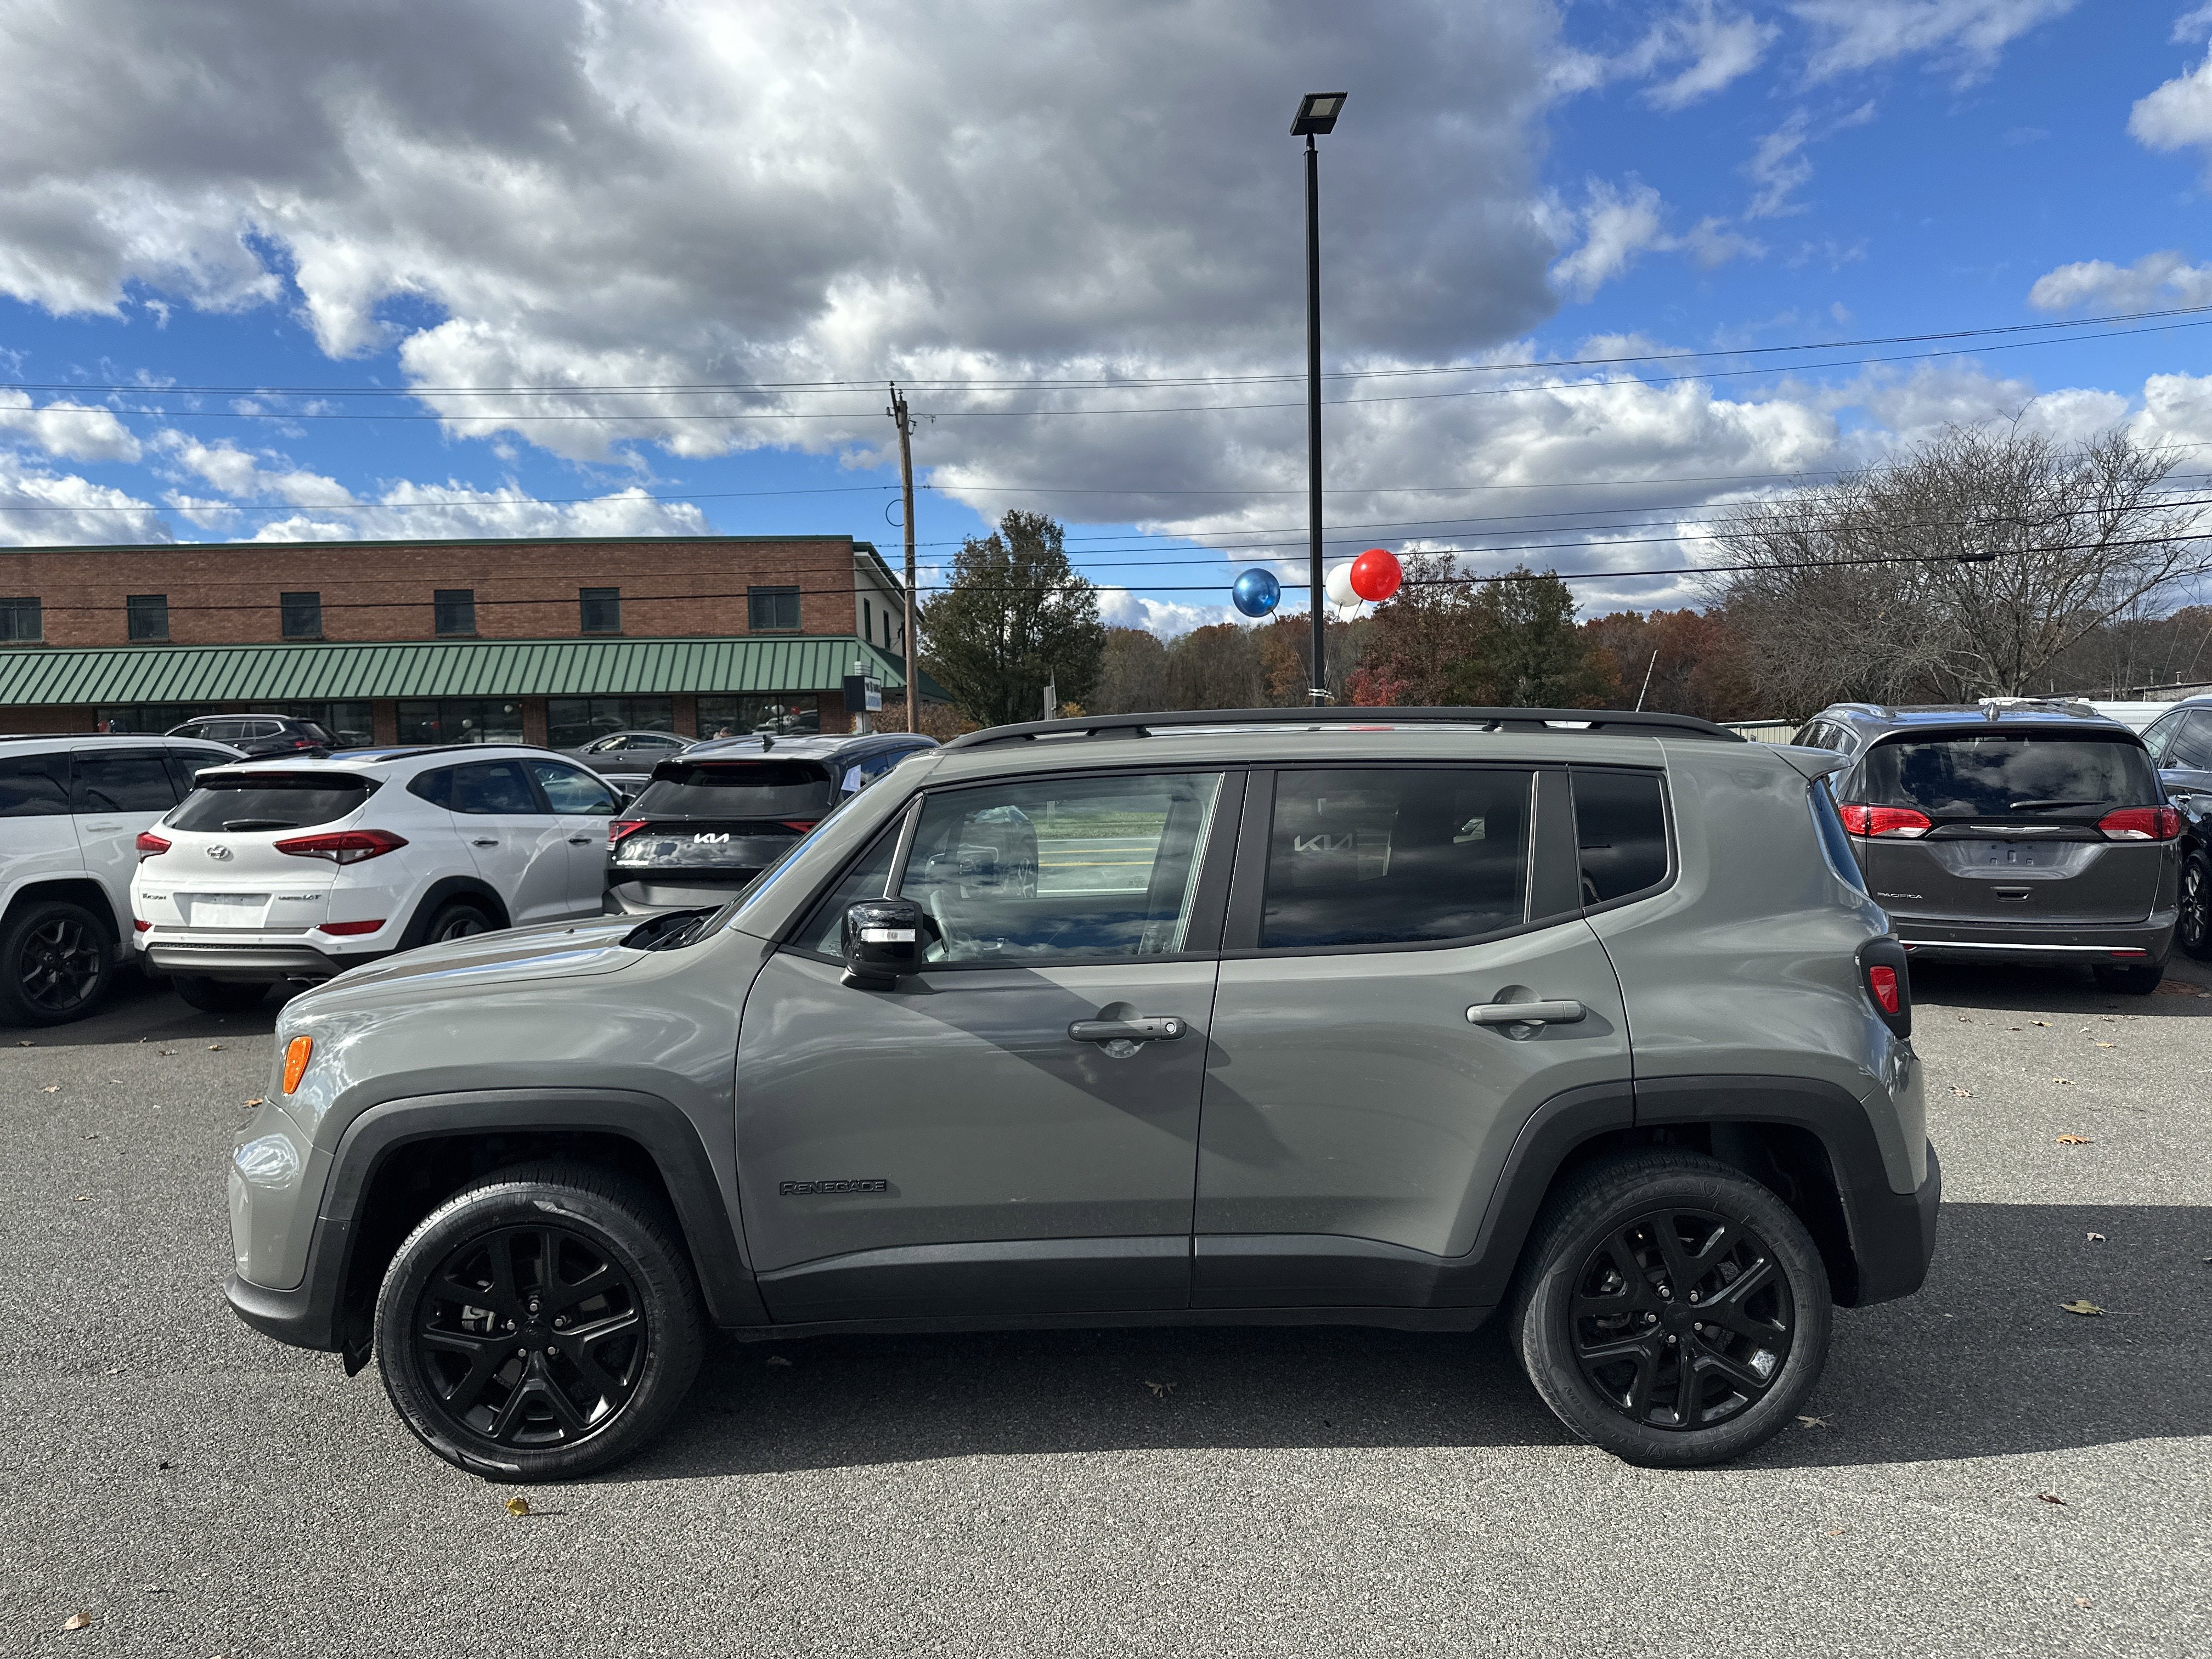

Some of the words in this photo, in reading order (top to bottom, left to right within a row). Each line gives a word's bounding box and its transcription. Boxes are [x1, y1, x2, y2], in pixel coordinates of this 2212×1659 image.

[694, 833, 729, 843] KIA
[1294, 833, 1353, 851] KIA
[779, 1179, 887, 1195] RENEGADE
